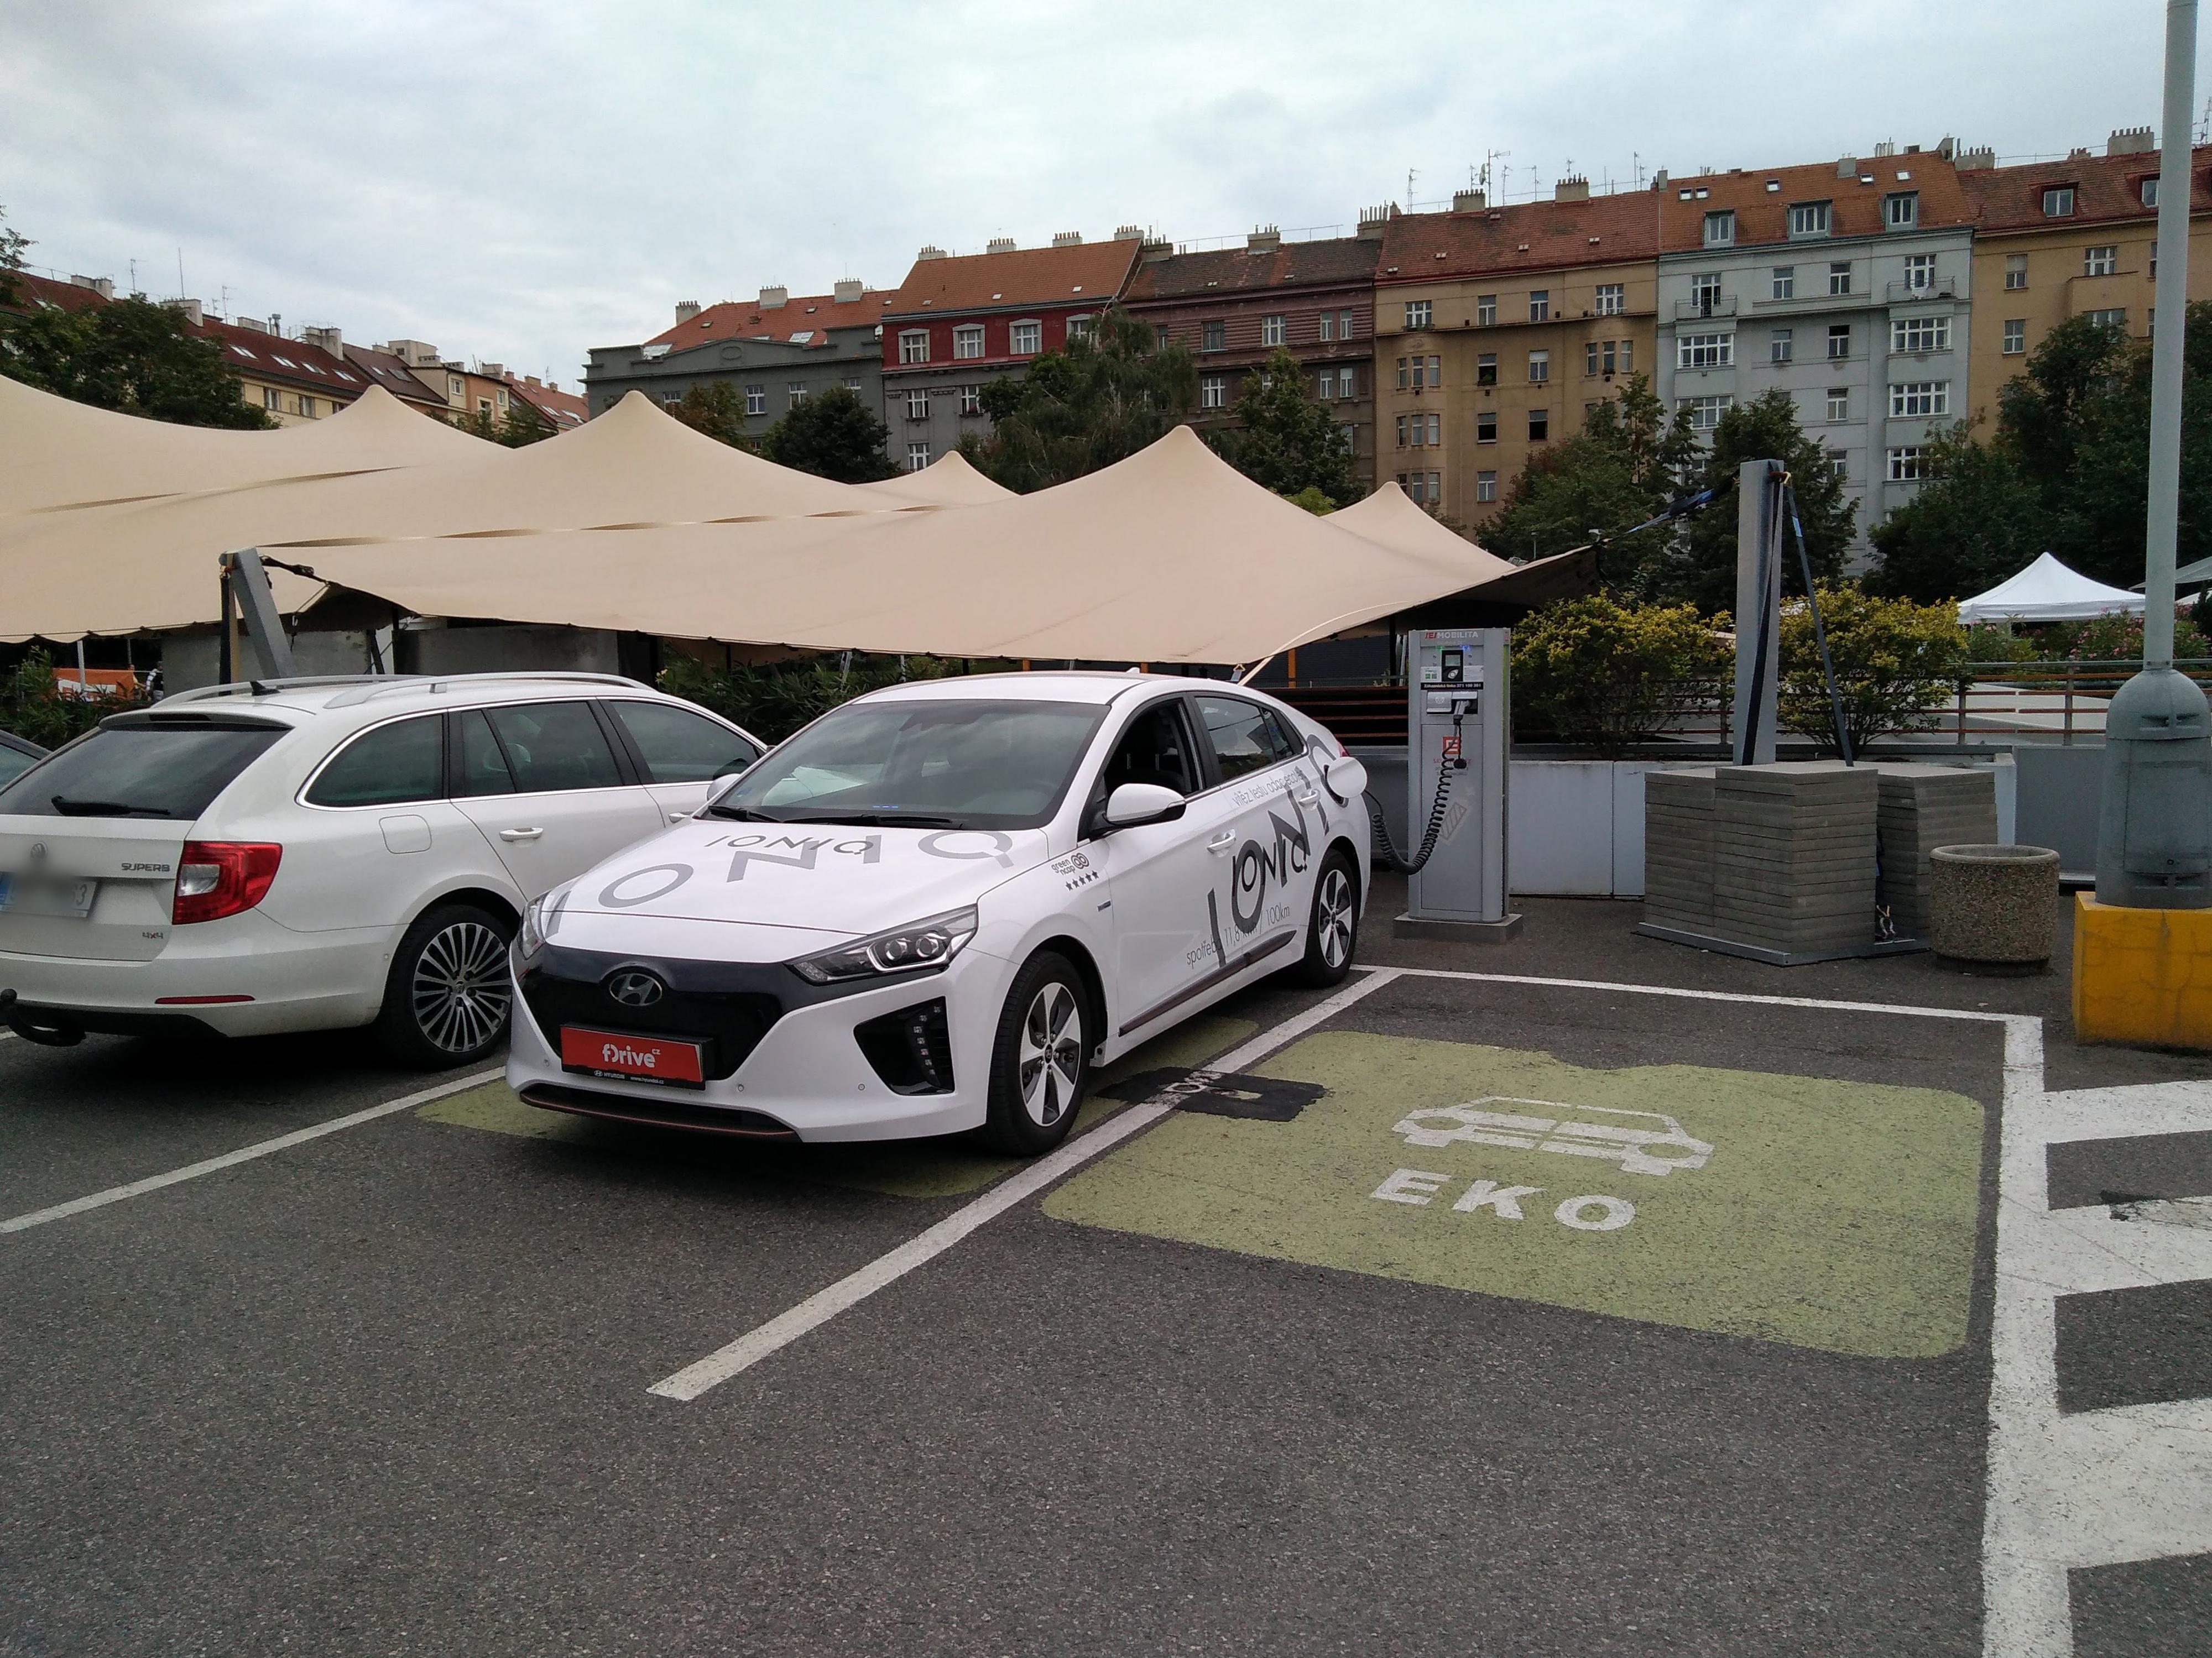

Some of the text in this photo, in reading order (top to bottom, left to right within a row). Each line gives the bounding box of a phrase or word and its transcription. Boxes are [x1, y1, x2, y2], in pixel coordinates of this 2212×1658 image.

[705, 835, 873, 855] IONIQ
[121, 862, 170, 872] SUPERB
[1051, 859, 1071, 874] green
[1060, 865, 1076, 875] ncap
[630, 1076, 664, 1084] www.hyundai.cz
[1369, 1168, 1636, 1231] EKO
